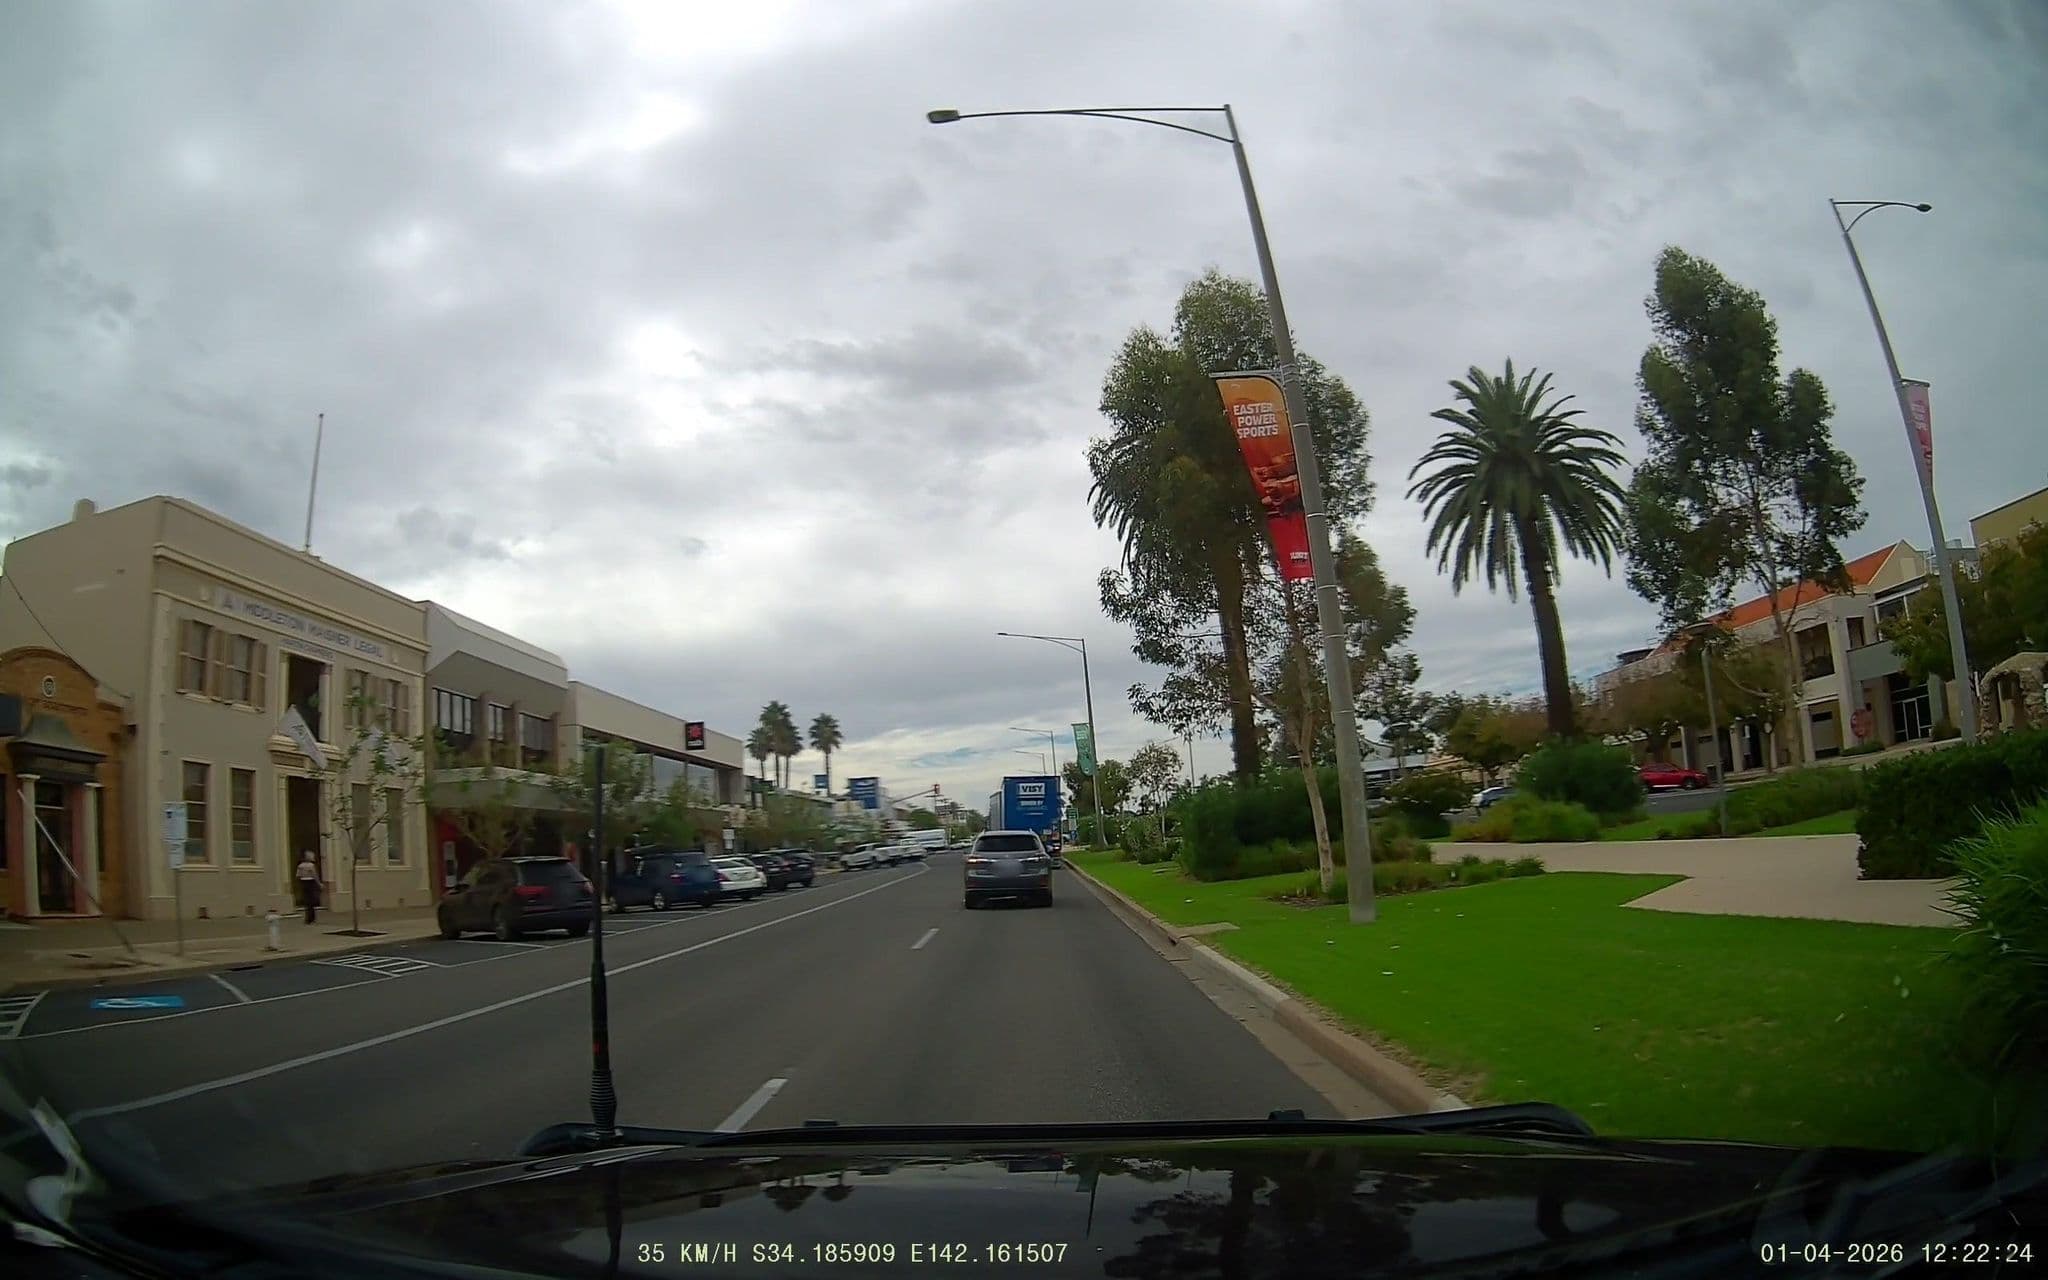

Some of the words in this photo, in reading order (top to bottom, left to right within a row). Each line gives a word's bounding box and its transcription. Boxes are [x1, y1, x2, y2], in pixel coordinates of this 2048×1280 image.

[1233, 402, 1273, 416] EASTER
[1237, 413, 1278, 427] POWER
[1236, 424, 1279, 439] SPORTS
[354, 638, 383, 658] LEGAL
[1021, 785, 1043, 793] VISY
